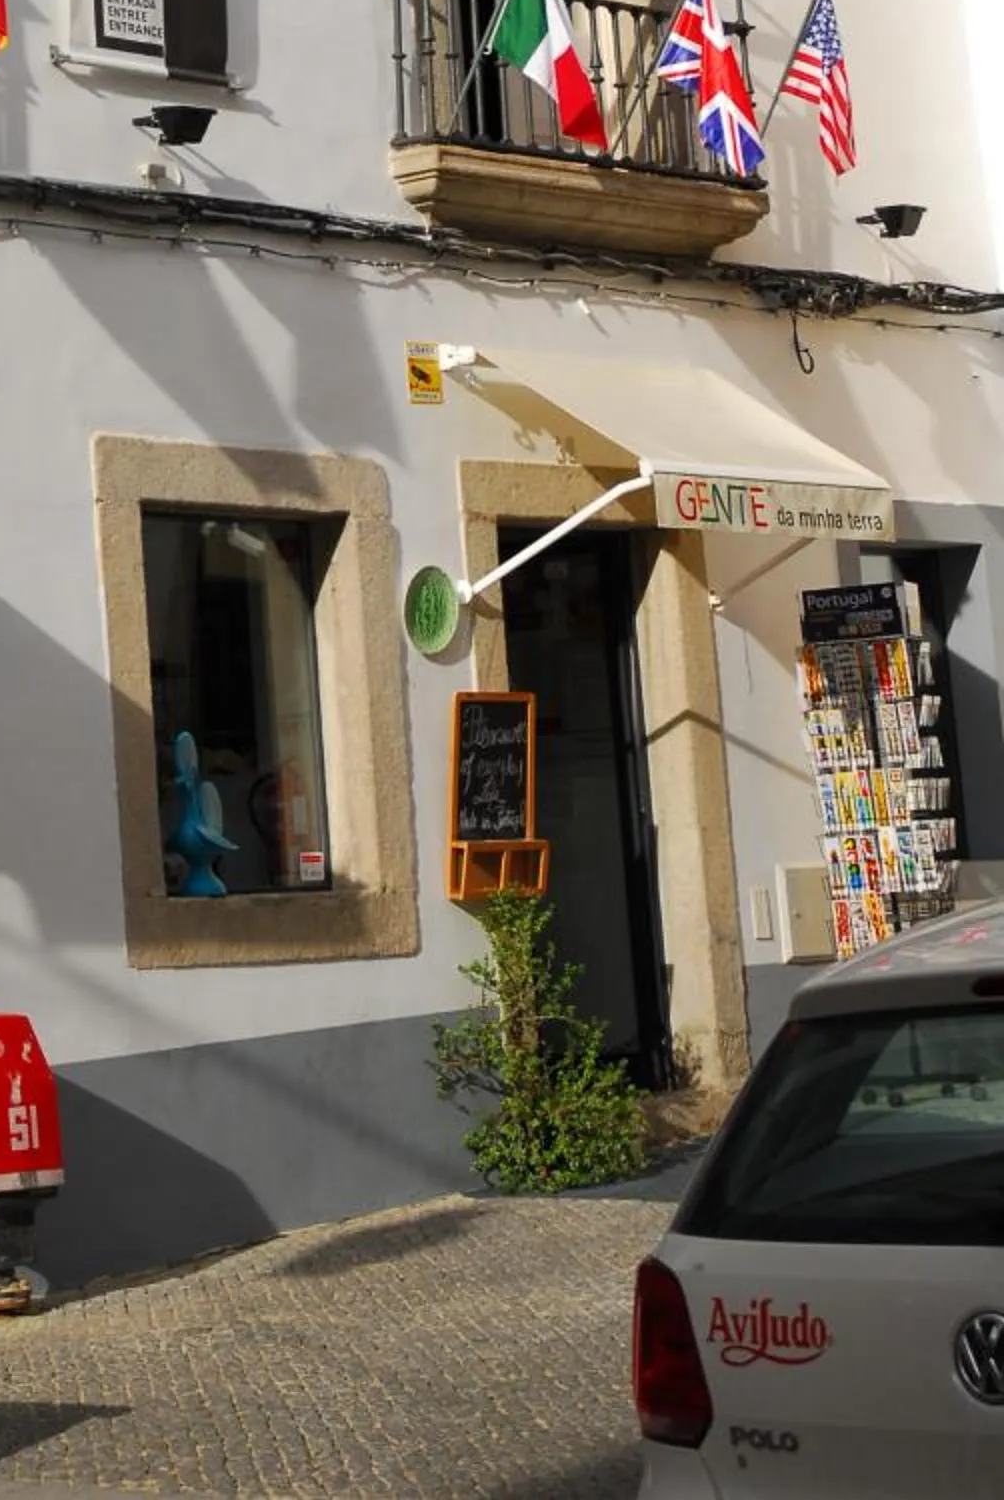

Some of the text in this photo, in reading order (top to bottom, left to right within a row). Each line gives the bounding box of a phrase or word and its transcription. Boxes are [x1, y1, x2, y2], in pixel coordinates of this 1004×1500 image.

[109, 19, 164, 39] ENTRANCE
[676, 480, 883, 531] GENTE da minha terra
[806, 588, 873, 611] Portugal
[730, 1426, 799, 1452] POLO
